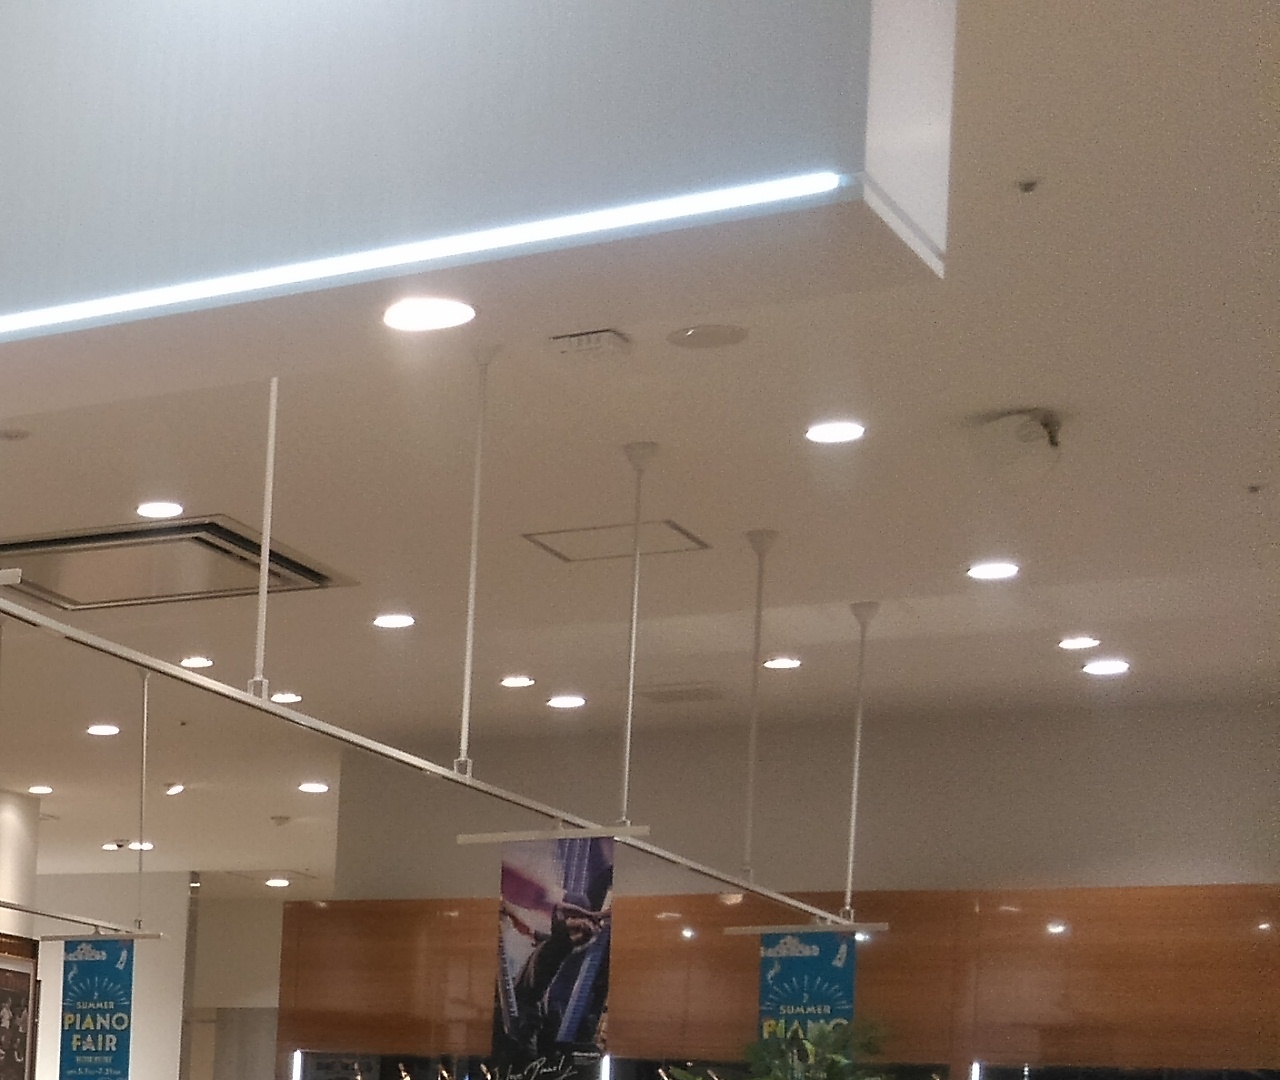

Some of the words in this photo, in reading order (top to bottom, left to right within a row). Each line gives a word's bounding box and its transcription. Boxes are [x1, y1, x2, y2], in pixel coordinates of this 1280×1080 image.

[76, 1001, 115, 1010] SUMMER
[780, 1005, 831, 1014] SUMMER
[64, 1012, 129, 1031] PIANO
[72, 1034, 117, 1052] FAIR
